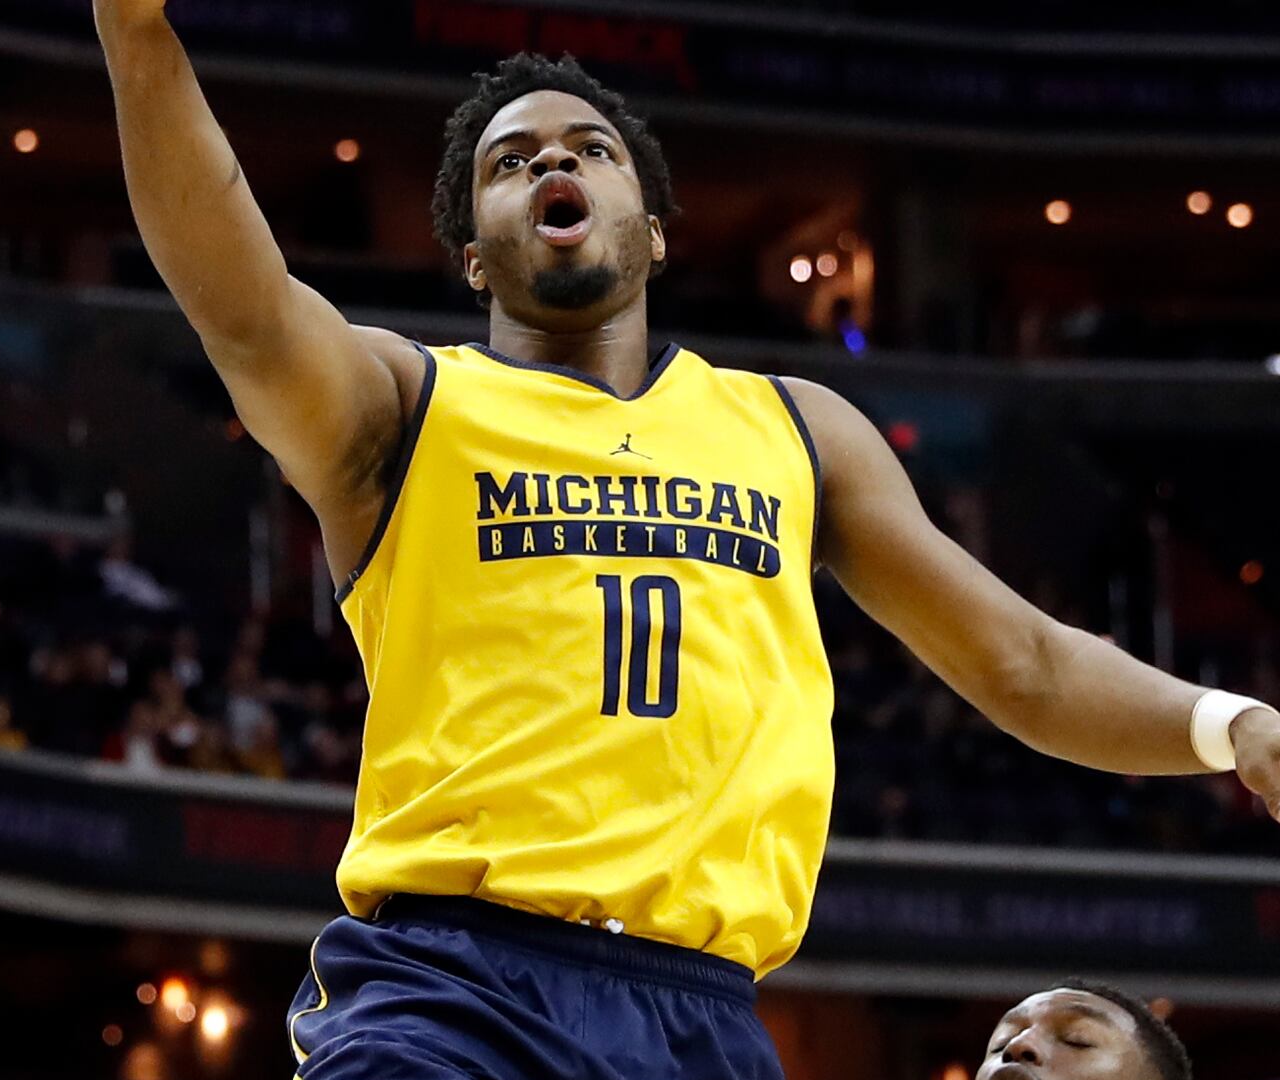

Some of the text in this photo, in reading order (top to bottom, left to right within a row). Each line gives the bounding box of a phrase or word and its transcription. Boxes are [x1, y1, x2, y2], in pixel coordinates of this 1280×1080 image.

[474, 472, 781, 542] MICHIGAN
[491, 524, 767, 573] BASKETBALL
[596, 574, 681, 719] 10
